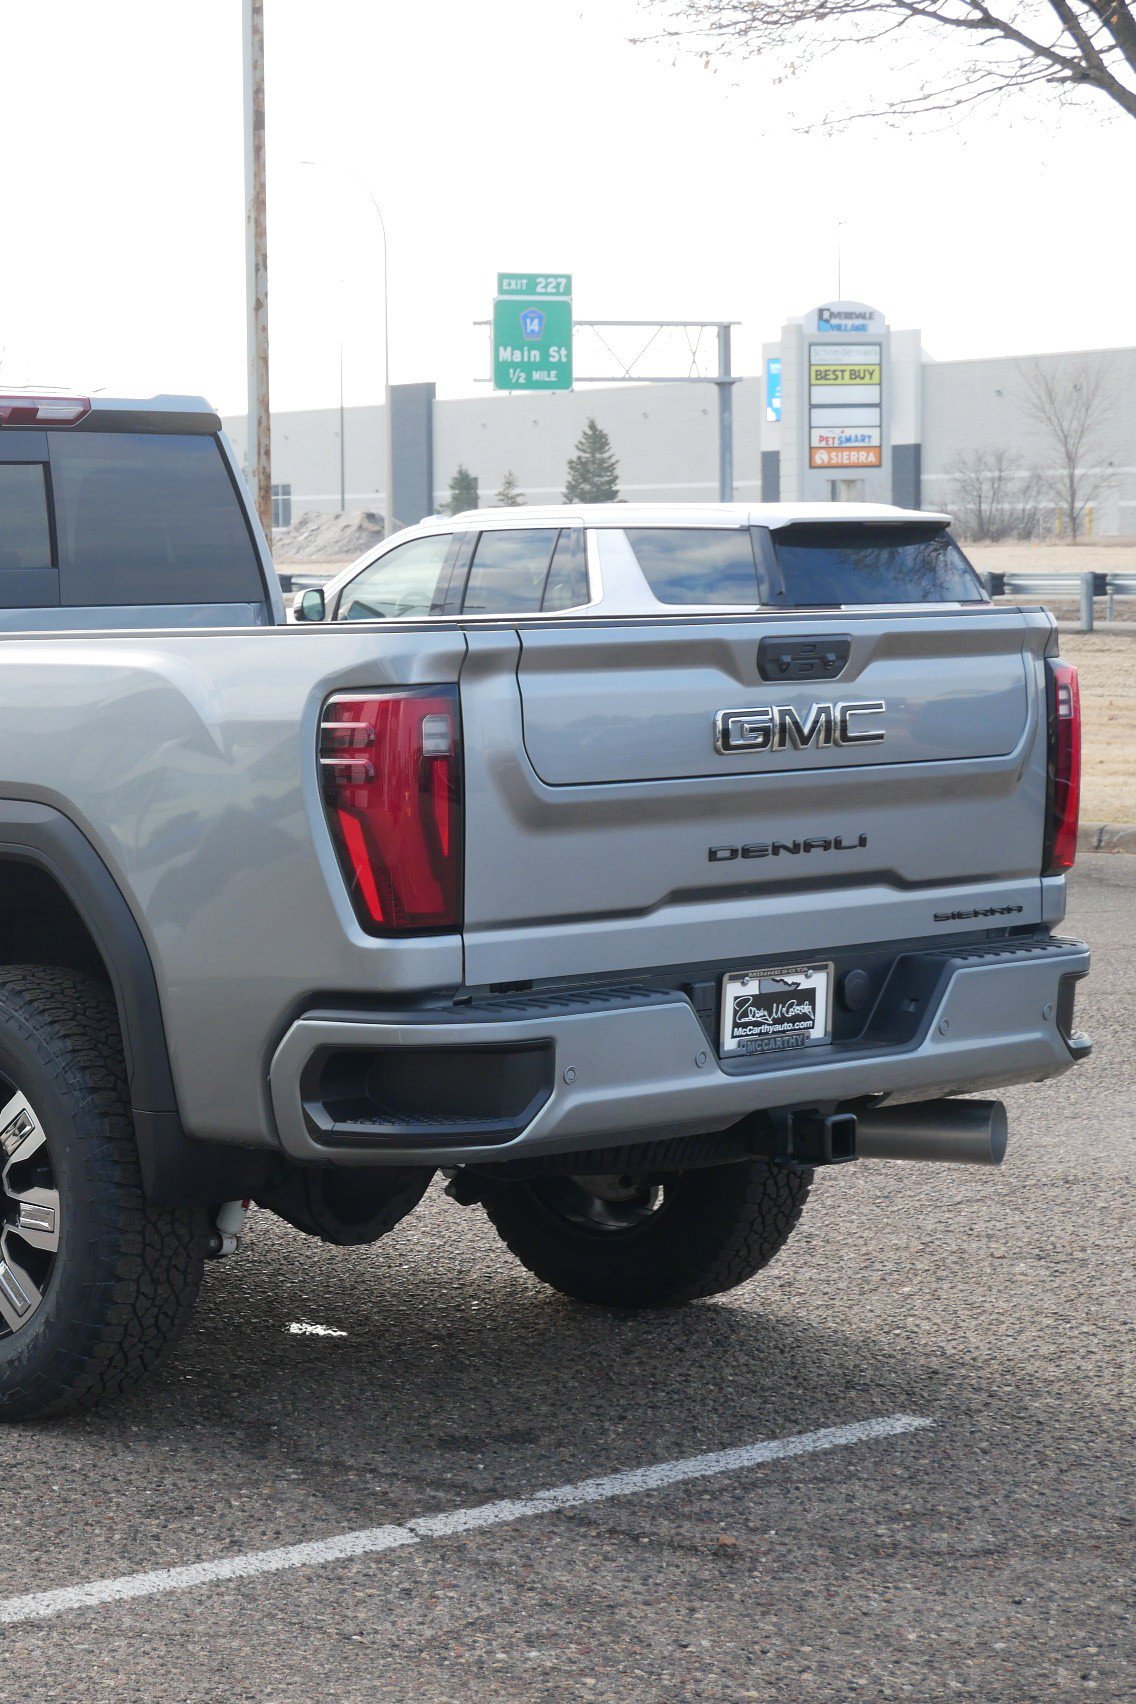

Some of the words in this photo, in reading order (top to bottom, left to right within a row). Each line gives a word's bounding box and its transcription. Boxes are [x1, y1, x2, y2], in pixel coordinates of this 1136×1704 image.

[502, 279, 528, 290] EXIT
[535, 277, 567, 293] 227
[526, 318, 540, 333] 14
[498, 346, 540, 362] Main
[548, 346, 568, 362] St
[532, 370, 558, 381] MILE
[815, 369, 846, 381] BEST
[849, 368, 876, 380] BUY
[830, 450, 877, 464] SIERRA
[714, 700, 886, 756] GMC
[708, 832, 868, 863] DENALI
[933, 904, 1024, 922] SIERRA
[748, 967, 809, 978] MINNESOTA
[733, 1020, 813, 1036] McCarthyauto.com
[747, 1035, 803, 1053] MCCARTHY
